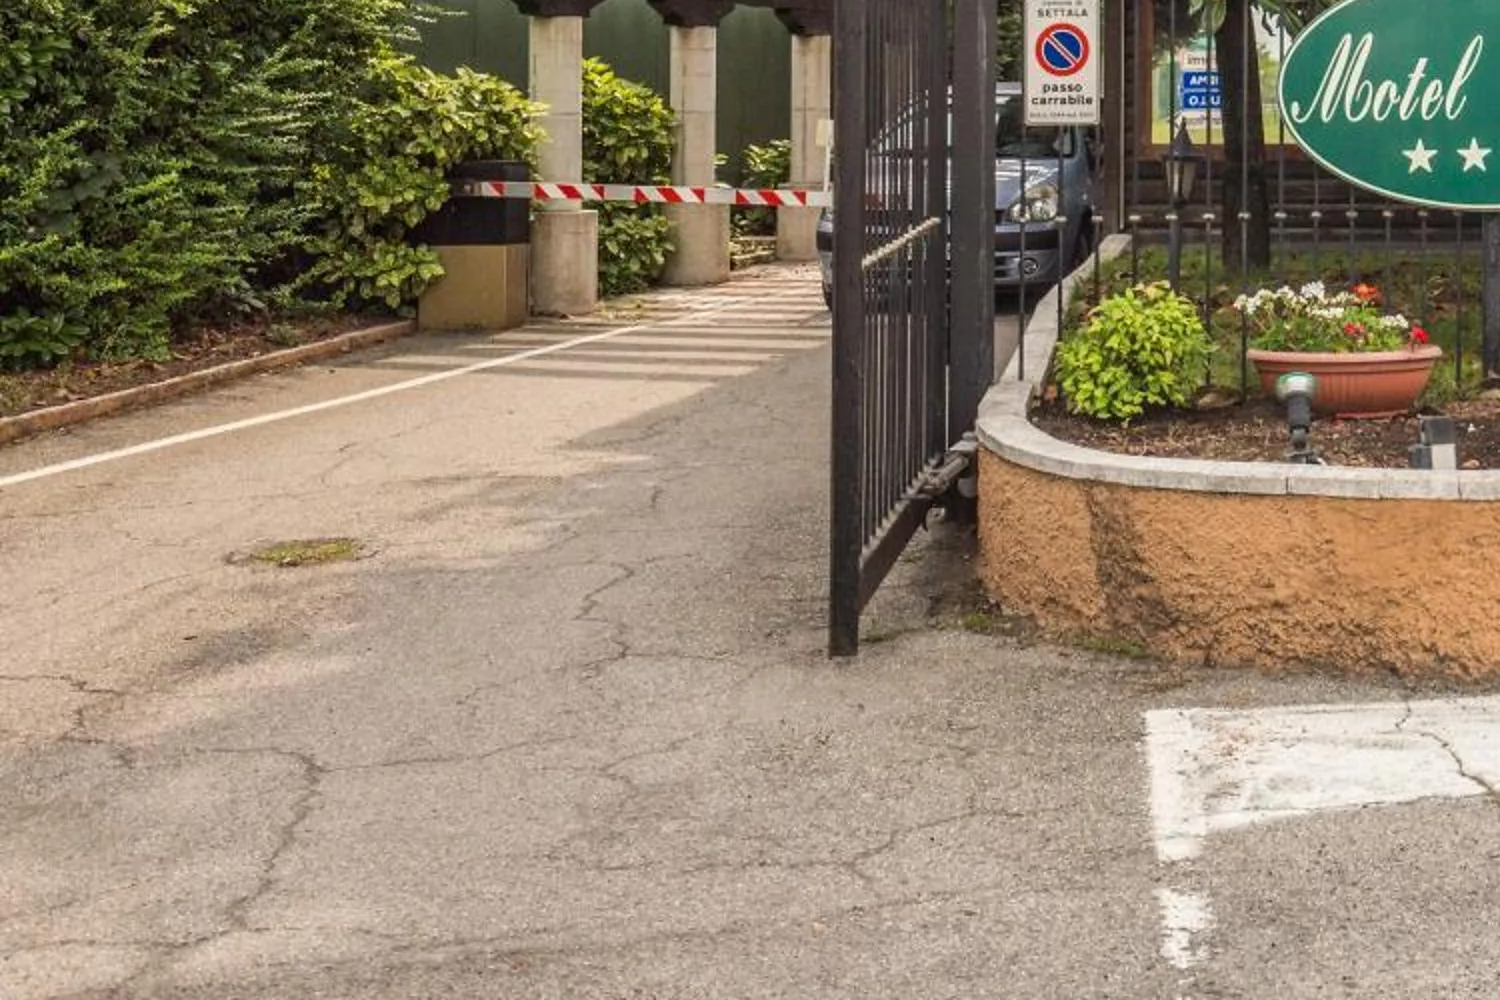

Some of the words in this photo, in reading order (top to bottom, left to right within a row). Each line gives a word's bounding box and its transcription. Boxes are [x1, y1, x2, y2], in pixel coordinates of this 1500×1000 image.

[1037, 8, 1088, 17] SETTALA
[1290, 32, 1484, 123] Motel
[1042, 82, 1083, 93] passo
[1031, 96, 1093, 105] carrabile
